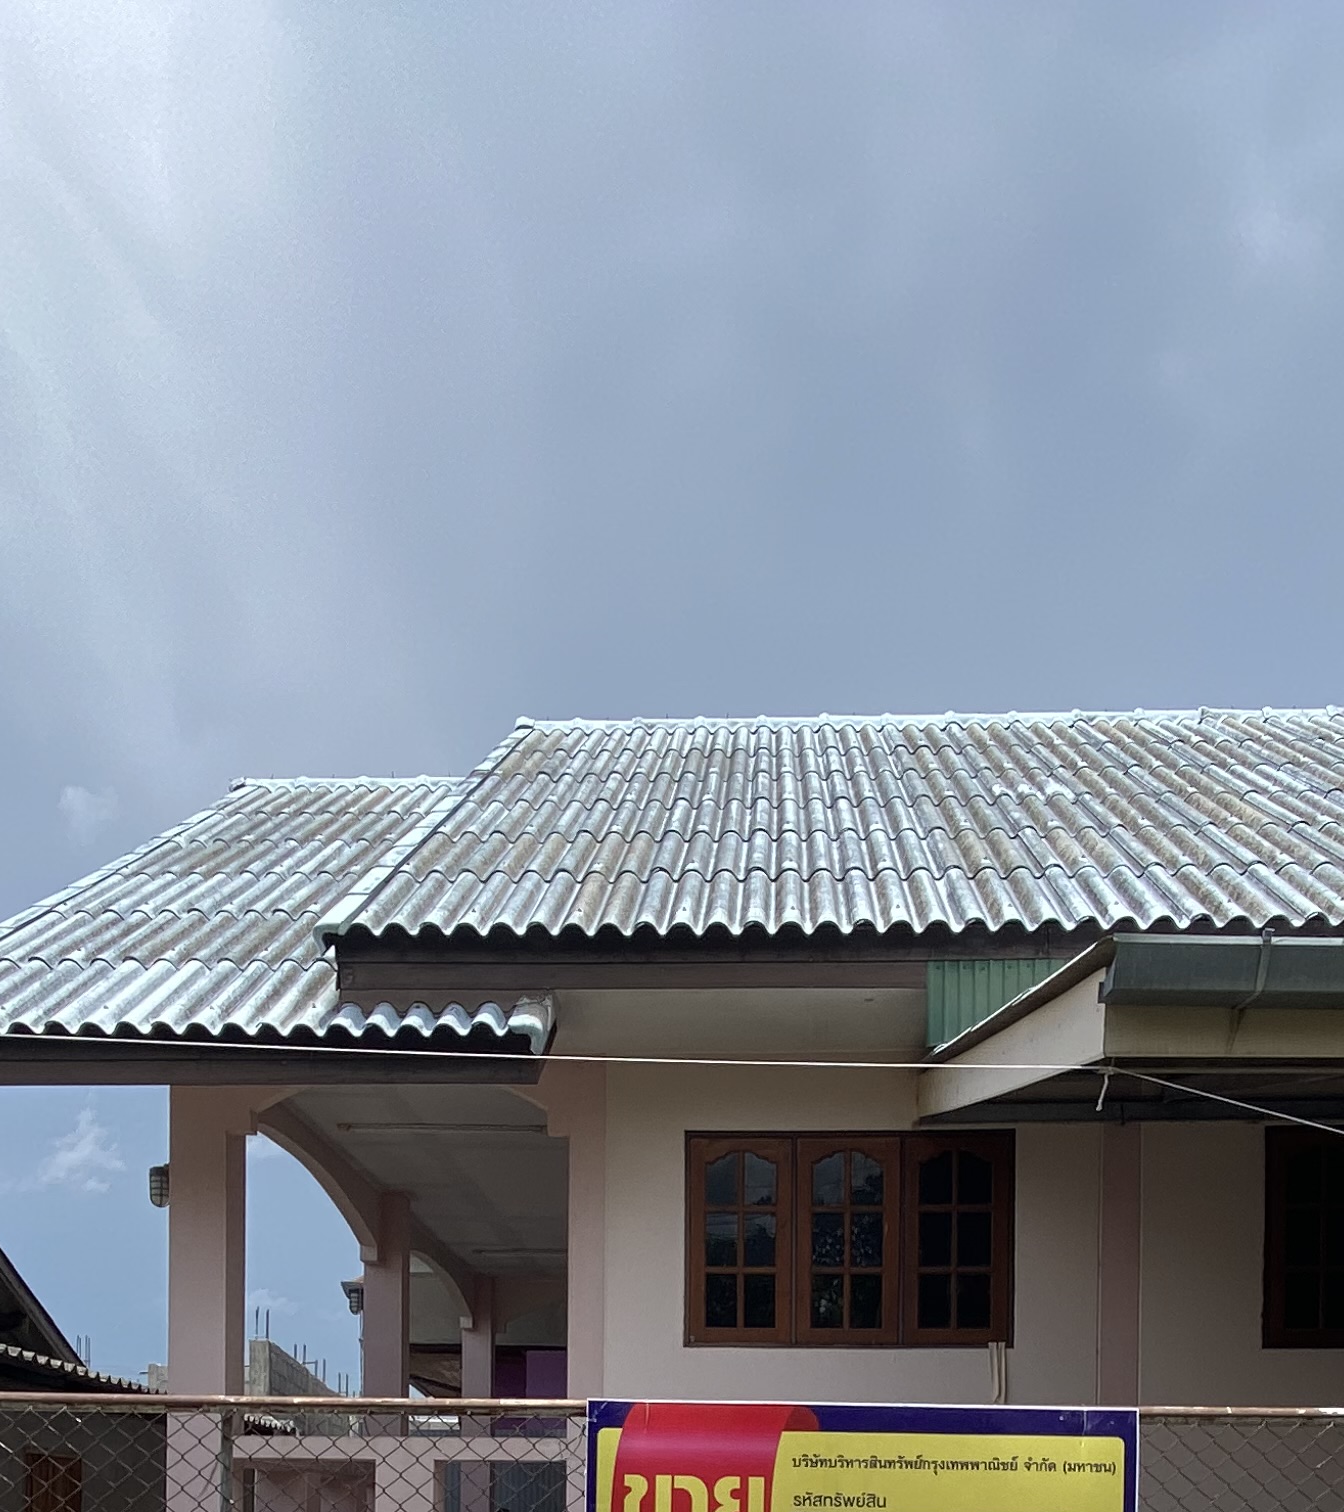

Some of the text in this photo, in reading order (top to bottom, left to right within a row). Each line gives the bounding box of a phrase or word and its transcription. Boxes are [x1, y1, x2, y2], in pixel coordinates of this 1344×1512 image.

[791, 1453, 1117, 1476] บริษัทบริหารสินทรัพย์กรุงเทพพาณิชย์ จำกัด (มหาชน)
[792, 1491, 887, 1509] รหัสทรัพย์สิน
